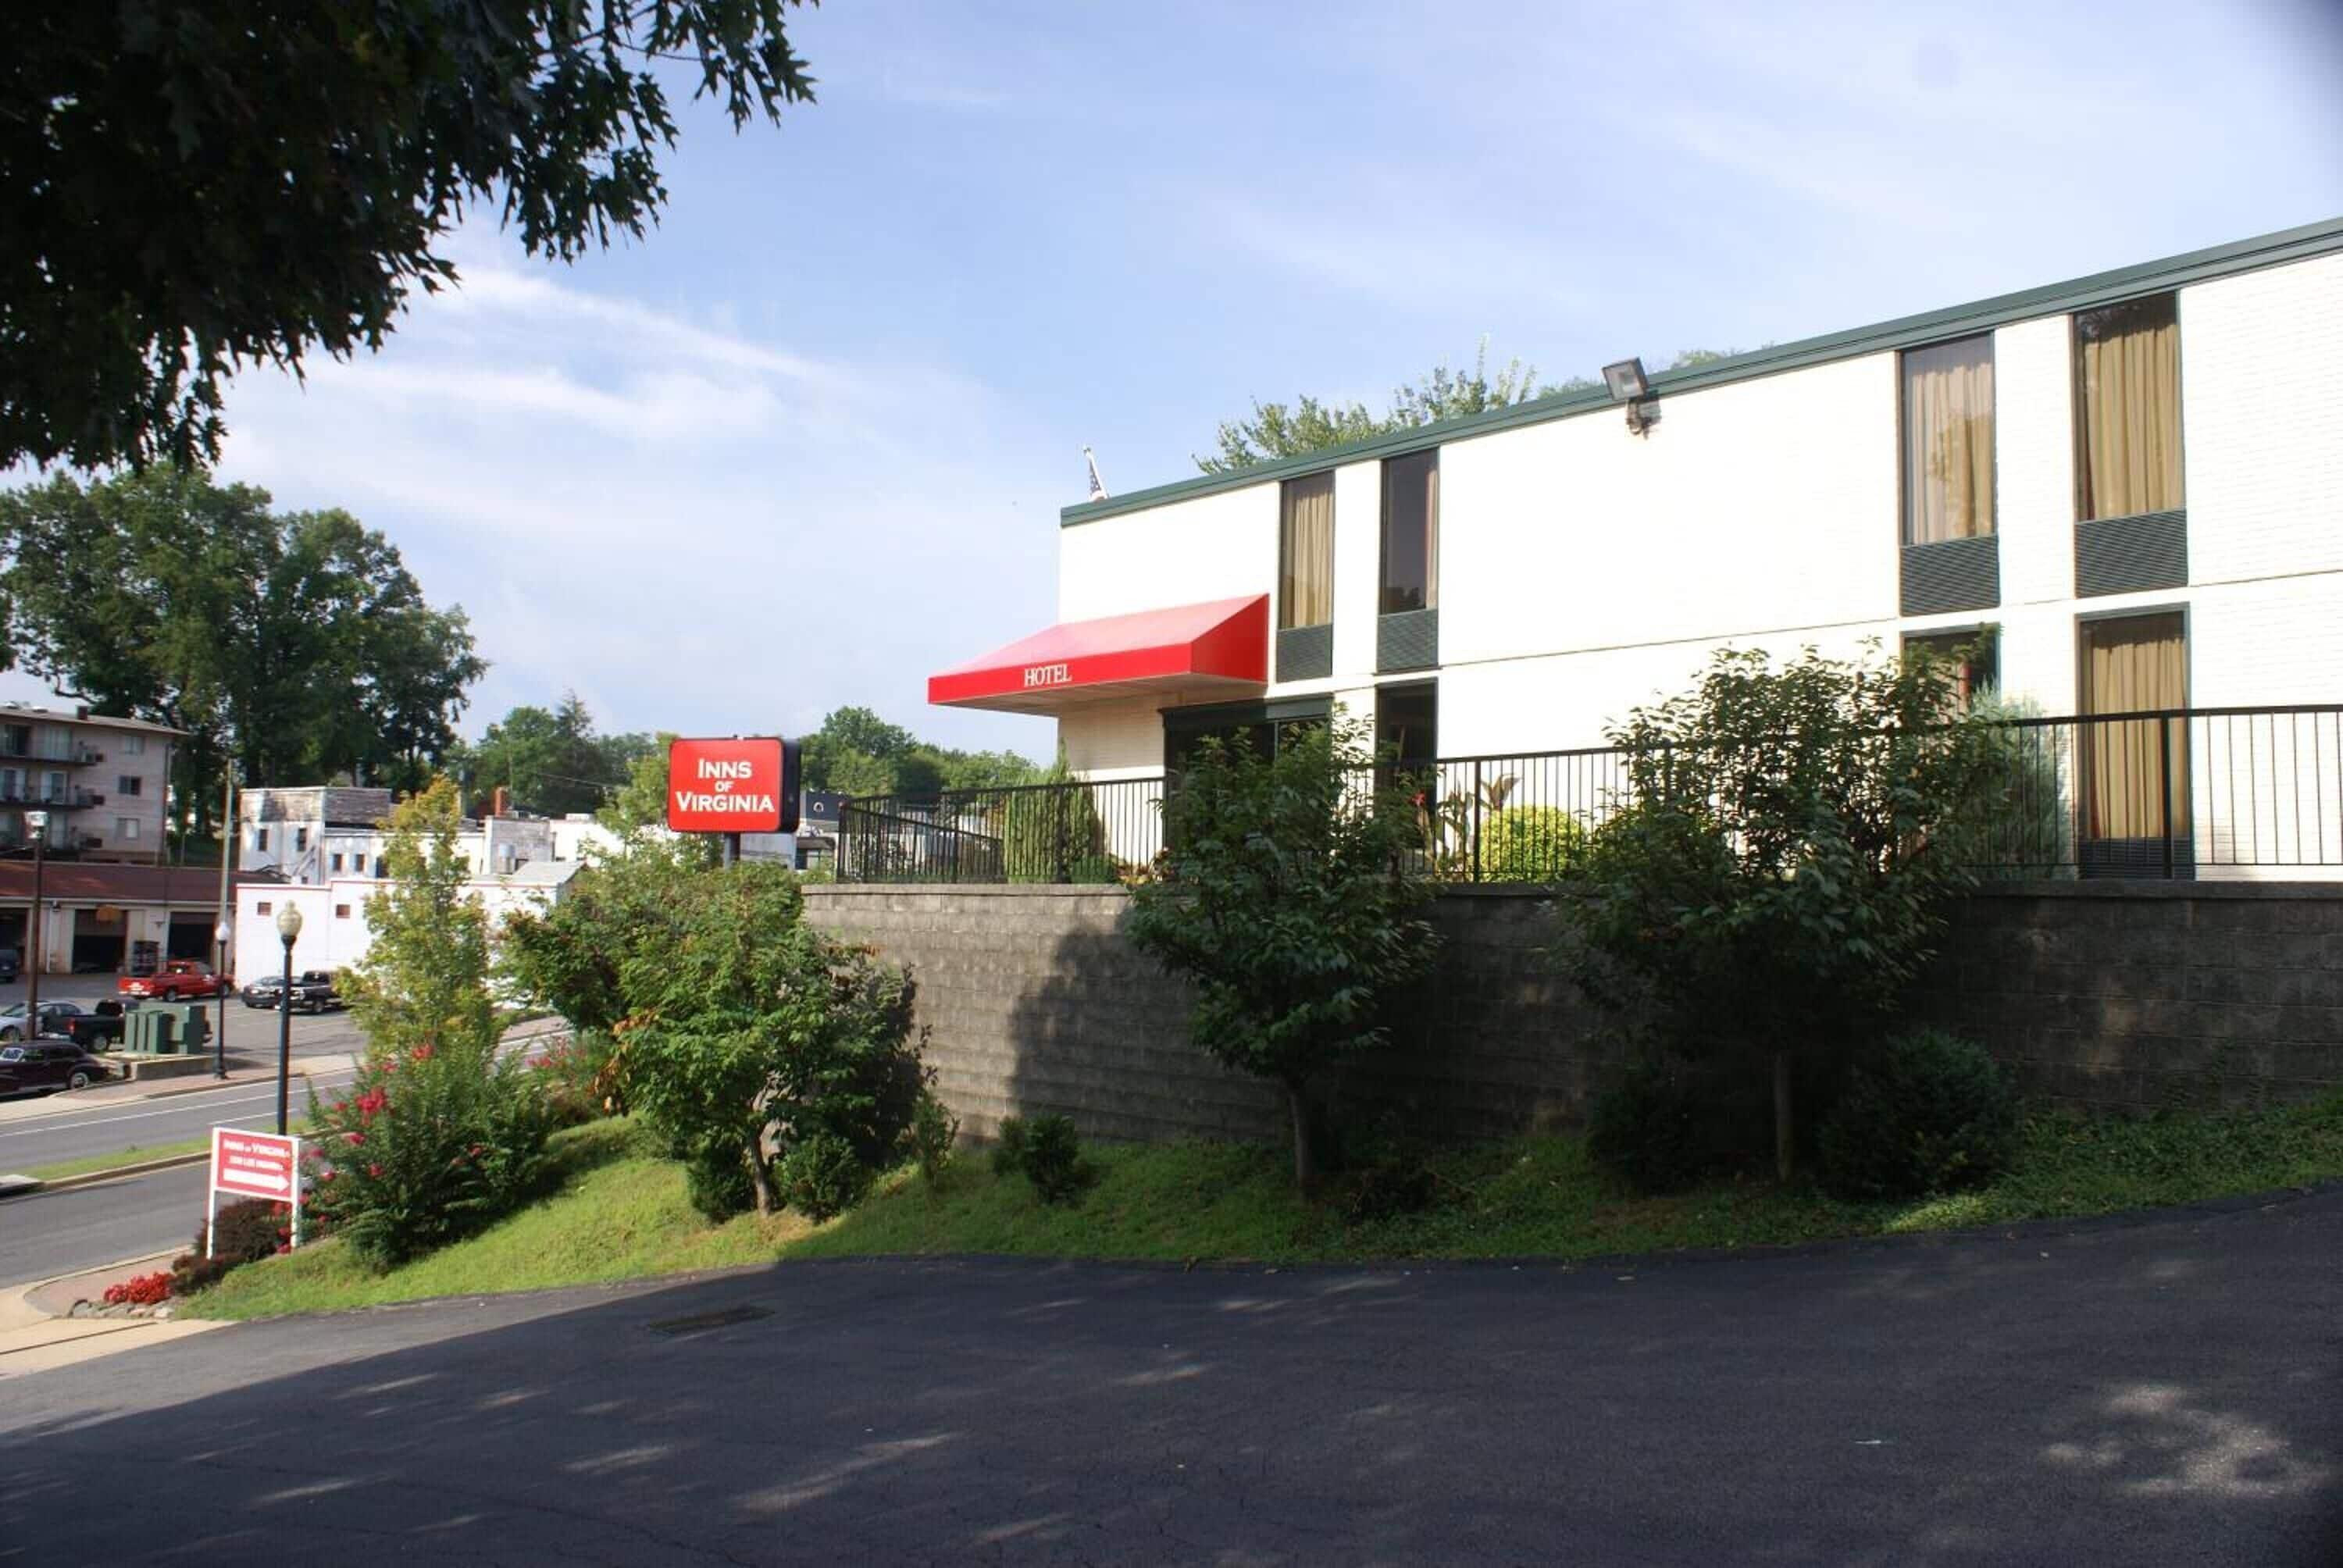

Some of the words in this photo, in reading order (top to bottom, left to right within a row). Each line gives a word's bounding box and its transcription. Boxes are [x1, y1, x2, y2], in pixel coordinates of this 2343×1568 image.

[1024, 663, 1072, 687] HOTEL
[697, 758, 753, 779] INNS
[676, 791, 776, 812] VIRGINIA
